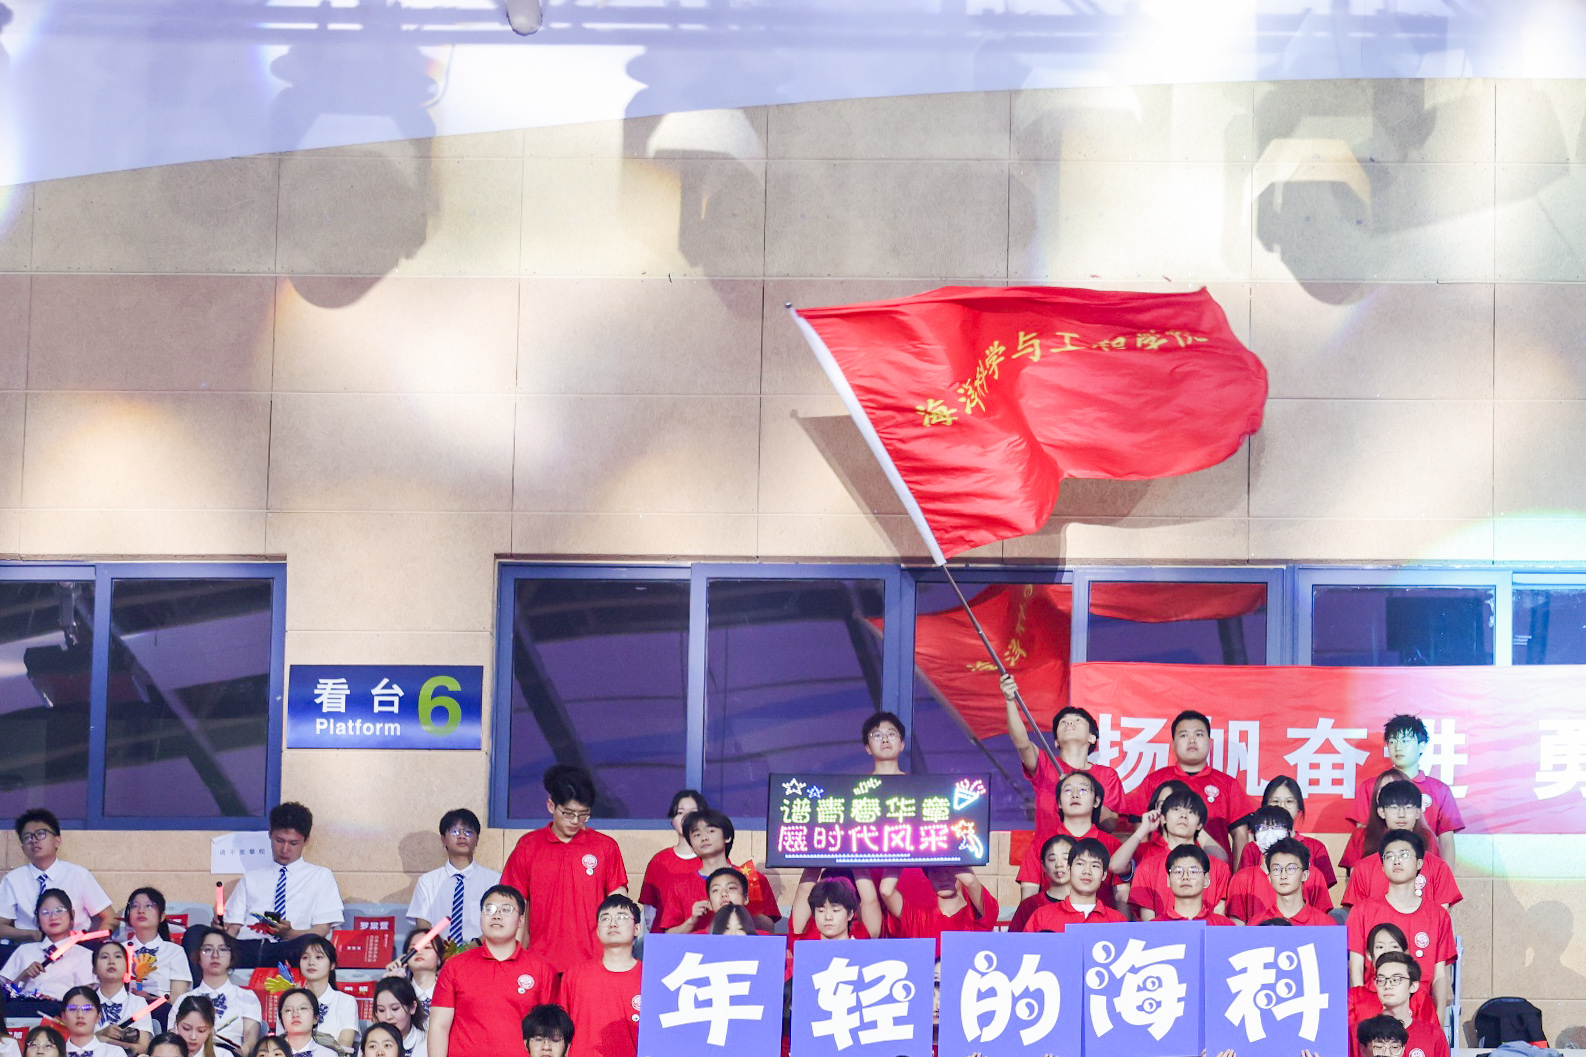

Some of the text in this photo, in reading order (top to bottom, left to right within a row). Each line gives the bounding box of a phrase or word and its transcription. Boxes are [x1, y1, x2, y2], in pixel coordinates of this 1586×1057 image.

[313, 677, 405, 714] 看台
[418, 675, 463, 736] 6
[314, 717, 402, 736] Platform
[779, 796, 951, 824] 谱青春华章
[777, 824, 949, 852] 展时代风采
[659, 938, 1330, 1050] 年轻的海科
